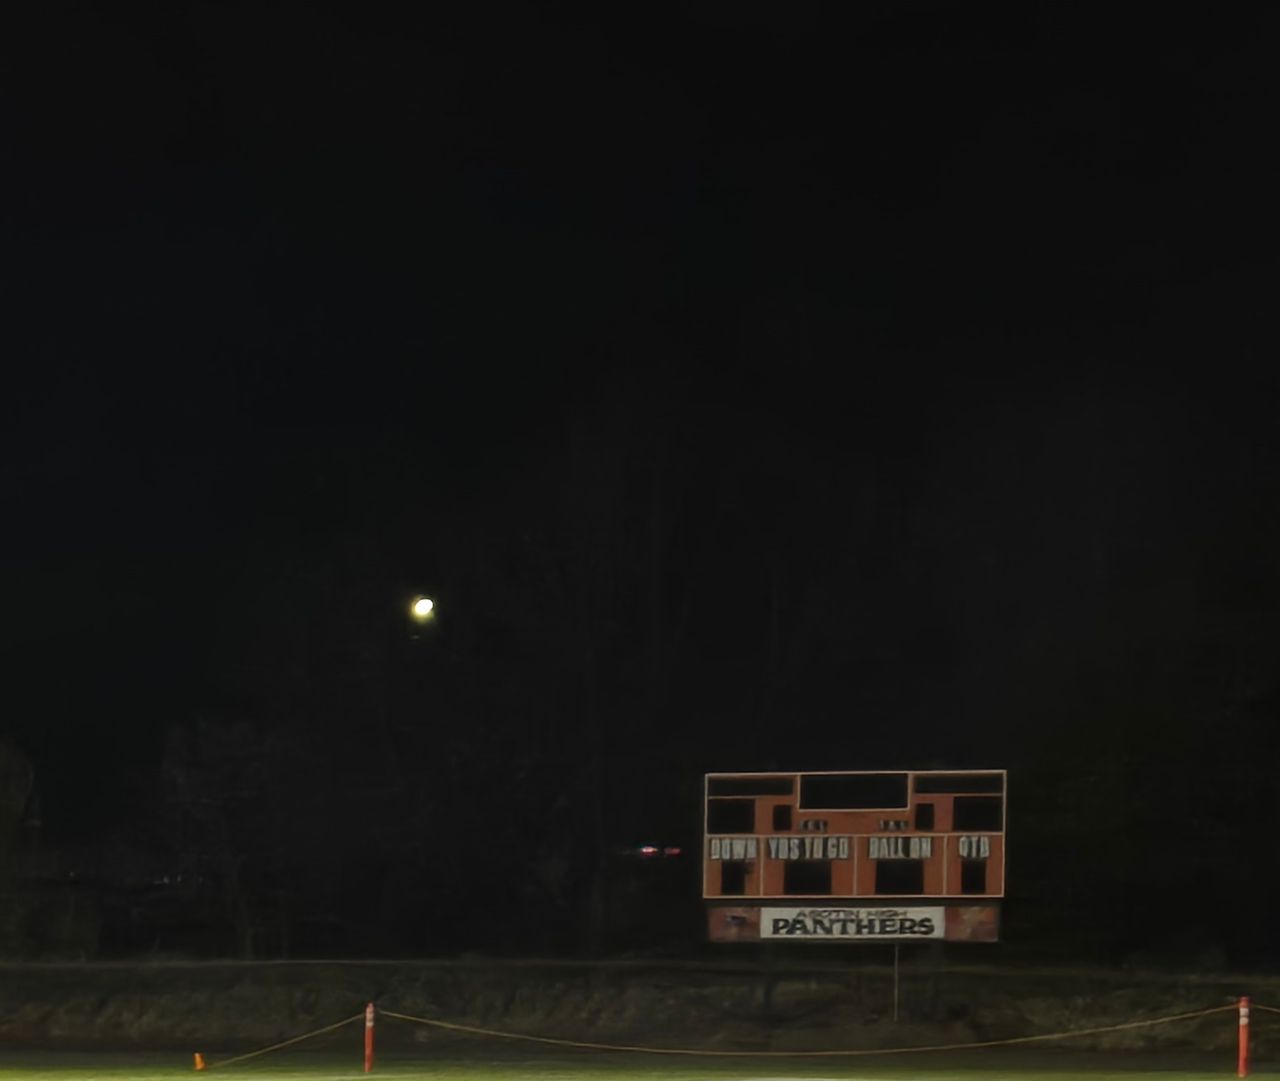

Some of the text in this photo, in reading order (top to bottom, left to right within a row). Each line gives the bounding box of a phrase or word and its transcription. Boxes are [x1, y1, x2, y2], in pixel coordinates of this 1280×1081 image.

[710, 838, 757, 860] DOWN
[804, 837, 824, 860] TO
[827, 837, 849, 860] GO
[869, 836, 931, 860] BALL ON
[772, 917, 935, 936] PANTHERS
